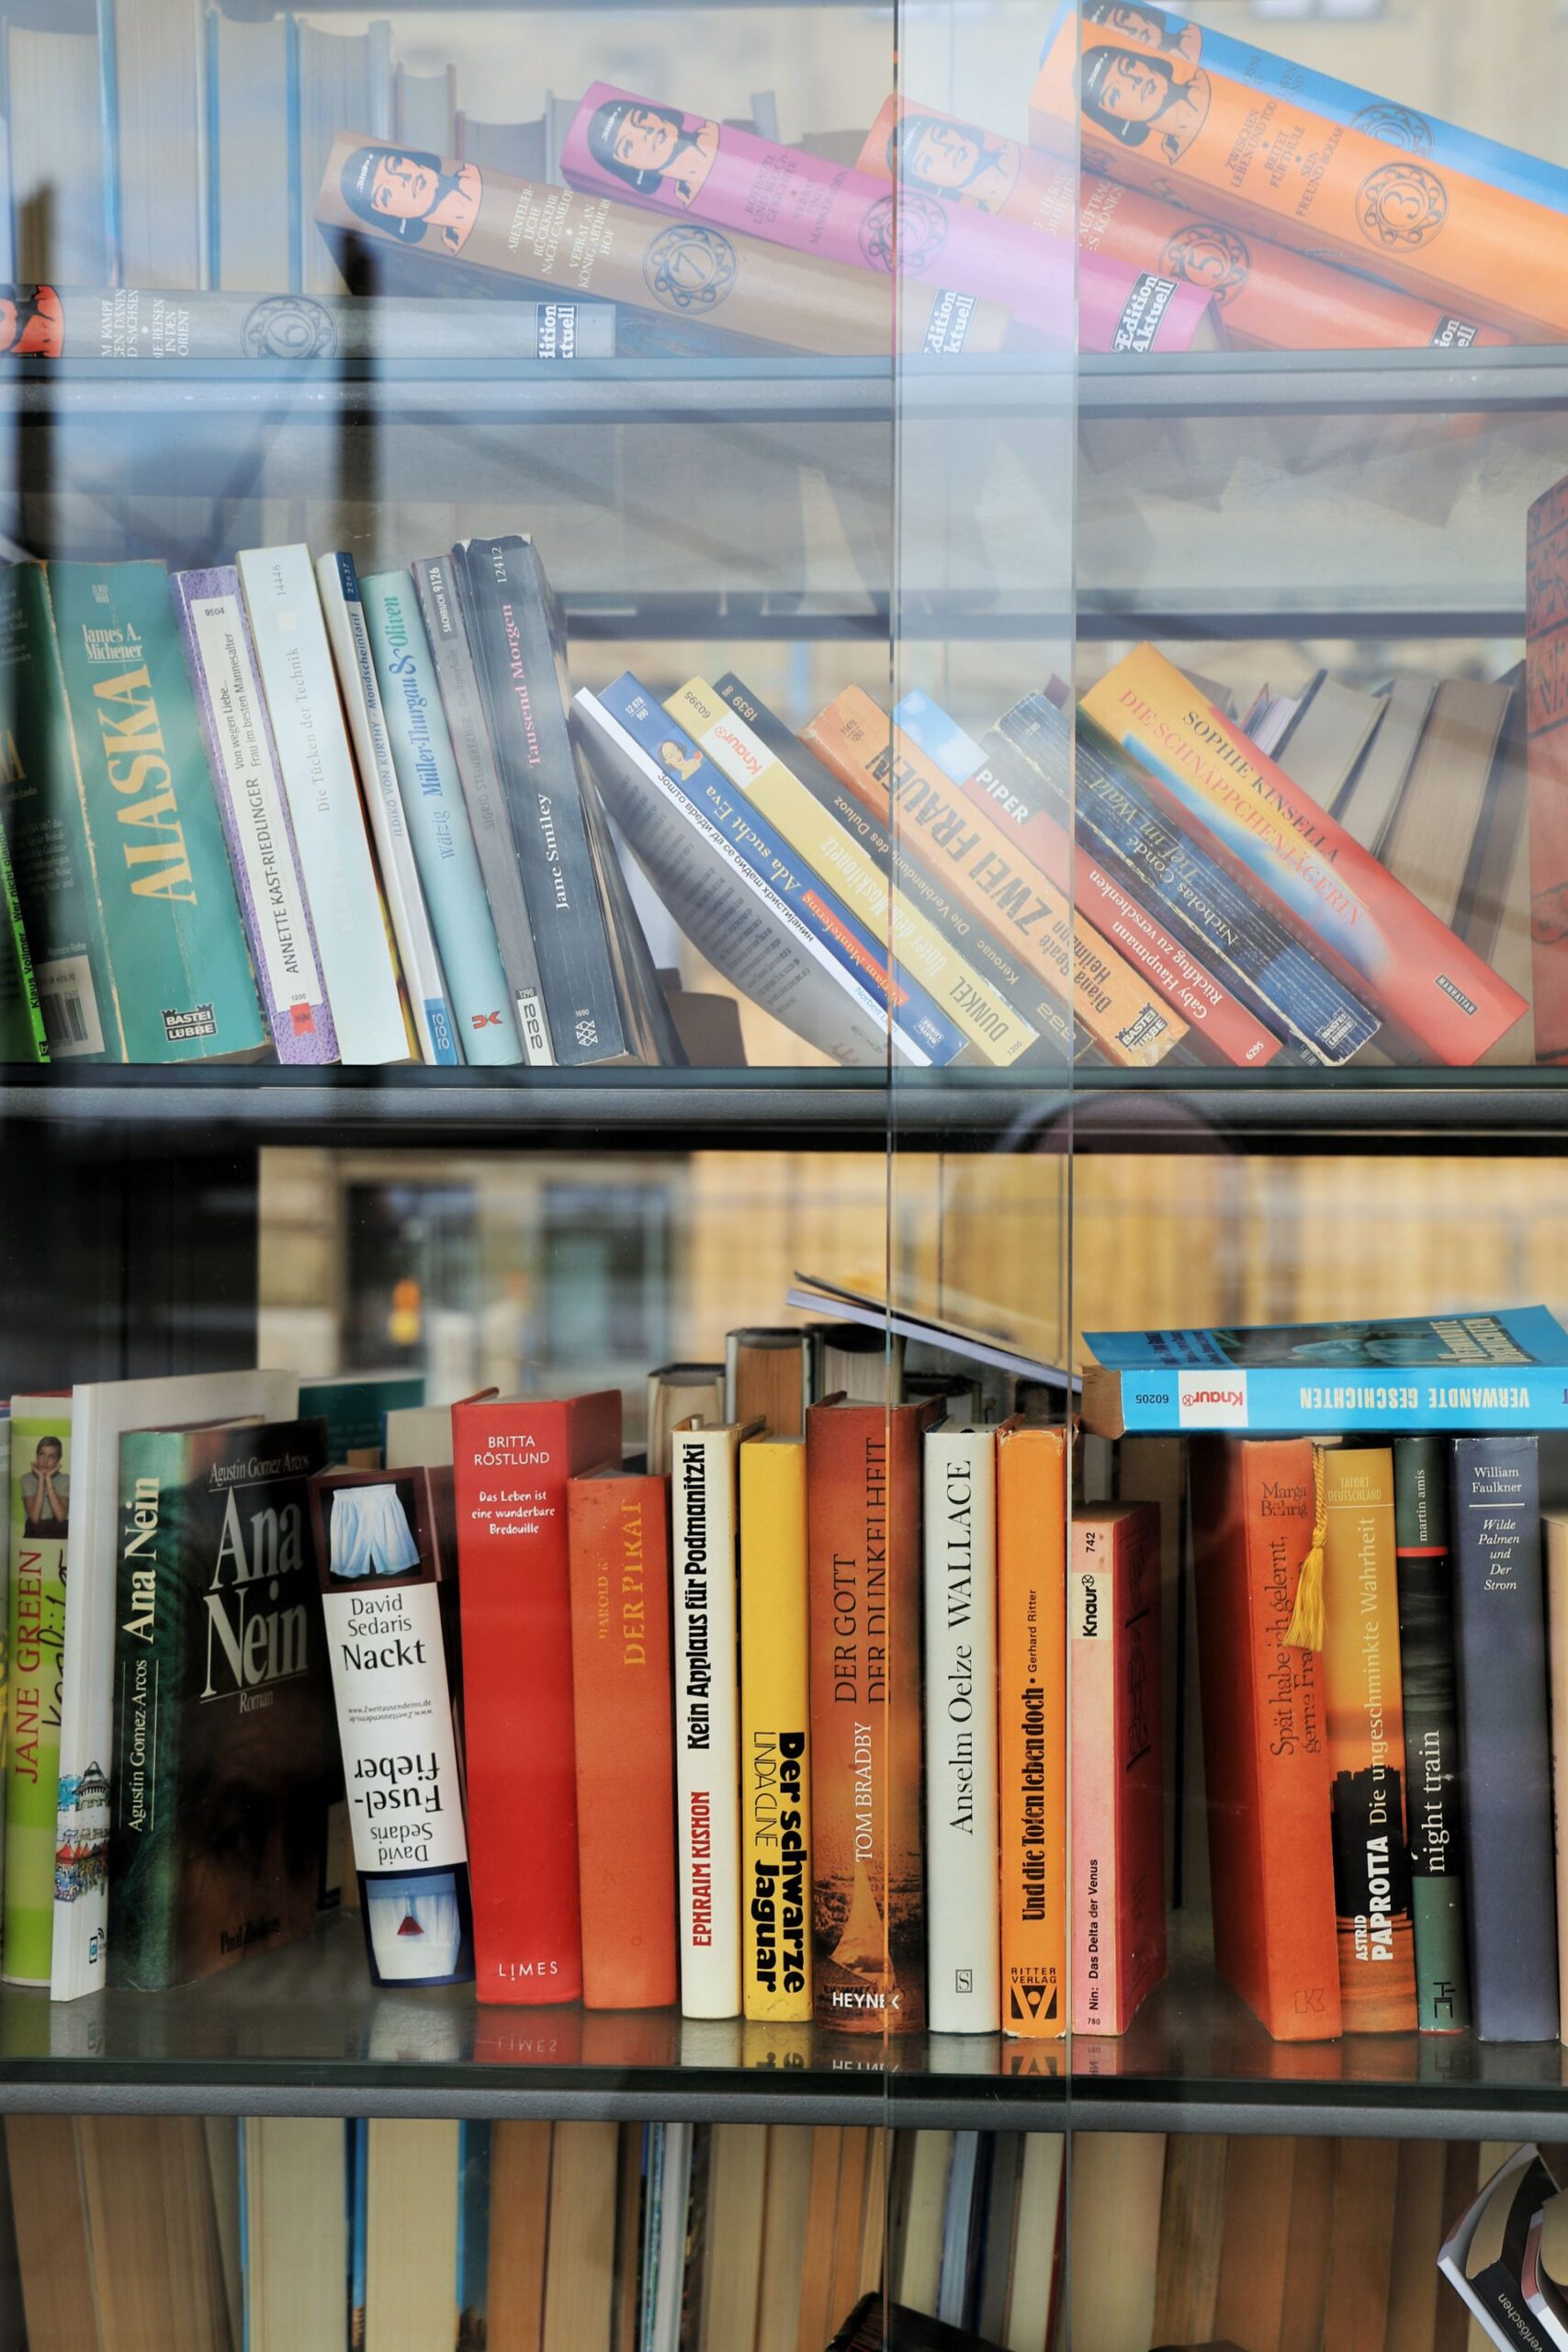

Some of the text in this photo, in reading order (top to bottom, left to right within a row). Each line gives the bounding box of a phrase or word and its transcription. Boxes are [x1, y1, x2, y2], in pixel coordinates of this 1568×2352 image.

[1225, 108, 1260, 170] ZWISCHEN
[1231, 101, 1277, 189] LEBEN TOD
[1301, 150, 1319, 178] SEIN
[1295, 166, 1325, 218] FREUND
[525, 206, 541, 241] LICHE
[534, 194, 559, 257] RÜCKKEHR
[570, 204, 596, 268] VERRAT AN
[599, 229, 615, 255] HOF
[542, 239, 559, 275] NACH
[579, 245, 597, 288] KÖNIG
[673, 253, 706, 280] 7
[1188, 255, 1225, 278] 5
[102, 300, 113, 338] KAMPF
[127, 289, 139, 343] SACHSEN
[153, 299, 165, 334] REISEN
[165, 311, 176, 353] IN DEN
[178, 309, 190, 356] ORIENT
[1111, 276, 1158, 353] Edition
[1134, 279, 1175, 353] Aktuell
[491, 546, 508, 584] 12412
[204, 606, 225, 617] 9504
[429, 567, 452, 634] SACHBUCH 9126
[82, 624, 124, 642] James
[85, 643, 143, 661] Michener
[224, 633, 262, 768] Frau besten Mannesalter
[382, 596, 445, 797] Müller-Thurgau Oliven
[502, 604, 541, 769] Tausend Morgen
[683, 691, 712, 719] 60395
[732, 696, 759, 722] 1839
[1119, 689, 1157, 728] DIE
[229, 712, 245, 771] Von wegen
[93, 663, 197, 905] ALASKA
[379, 769, 396, 799] VON
[975, 768, 1031, 824] PIPER
[1182, 710, 1338, 864] SOPHIE KINSELLA
[537, 793, 570, 910] Jane Smiley
[658, 772, 815, 943] Зошто вреди да се бидеш христијанин
[705, 785, 802, 892] Ada sucht Eva
[865, 749, 1053, 936] ZWEI FRAUEN
[245, 778, 299, 974] ANNETTE KAST-RIEDLINGER
[834, 796, 1020, 985] Kerouac Die Duluoz
[1177, 883, 1239, 947] Nicholas
[1089, 869, 1224, 1009] Rückflug verschenken
[1112, 921, 1208, 1021] Gaby Hauptmann
[949, 976, 1010, 1043] DUNKEL
[1438, 977, 1476, 1014] MANHATTAN
[165, 1011, 211, 1026] BASTEI
[1122, 1009, 1157, 1046] BASTEI
[1246, 1041, 1265, 1060] 6295
[1299, 1386, 1530, 1409] VERWANDTE GESCHICHTEN
[474, 1451, 550, 1466] RÖSTLUND
[488, 1435, 536, 1449] BRITTA
[1261, 1482, 1307, 1499] Marga
[1340, 1476, 1370, 1489] TATORT
[1471, 1481, 1523, 1494] Faulkner
[1473, 1466, 1519, 1479] William
[471, 1506, 556, 1519] eine wunderbare
[479, 1489, 547, 1502] Das Leben ist
[1327, 1489, 1382, 1503] DEUTSCHLAND
[1415, 1468, 1428, 1543] martin amis
[209, 1486, 303, 1590] Ana
[489, 1522, 540, 1535] Bredouille
[1086, 1532, 1096, 1553] 742
[1477, 1533, 1521, 1546] Palmen
[1482, 1519, 1517, 1532] Wilde
[122, 1476, 160, 1644] Ana Nein
[1489, 1548, 1512, 1560] und
[1489, 1563, 1513, 1575] Der
[351, 1594, 403, 1617] David
[682, 1442, 711, 1749] Kein Applaus für Podmanitzki
[1483, 1578, 1518, 1590] Strom
[201, 1580, 309, 1698] Nein
[347, 1614, 412, 1638] Sedaris
[623, 1600, 646, 1665] DER
[833, 1554, 857, 1704] DER GOTT
[16, 1551, 42, 1784] JANE GREEN
[341, 1639, 427, 1671] Nackt
[946, 1459, 974, 1837] Anselm Oelze WALLACE
[239, 1691, 274, 1714] Roman
[127, 1658, 149, 1833] Agustin Gomez-Arcos
[1021, 1588, 1045, 1882] die leben Gerhard Ritter
[1269, 1700, 1296, 1756] Spät
[1359, 1516, 1394, 1962] PAPROTTA Die ungeschminkte Wahrheit
[354, 1751, 440, 1782] fieber
[354, 1784, 444, 1818] Fusel-
[754, 1731, 778, 1848] LINDA CLINE
[854, 1720, 873, 1863] TOM BRADBY
[1418, 1729, 1450, 1873] night train
[370, 1822, 434, 1842] Sedaris
[378, 1844, 429, 1865] David
[691, 1791, 713, 1947] EPHRAIM KISHON
[779, 1731, 807, 1994] Der schwarze
[750, 1860, 781, 1994] Jaguar
[1088, 1859, 1099, 1980] Das Delta der Venus
[1354, 1914, 1369, 1962] ASTRID
[1011, 1967, 1056, 1975] RITTER
[1011, 1975, 1058, 1984] VERLAG
